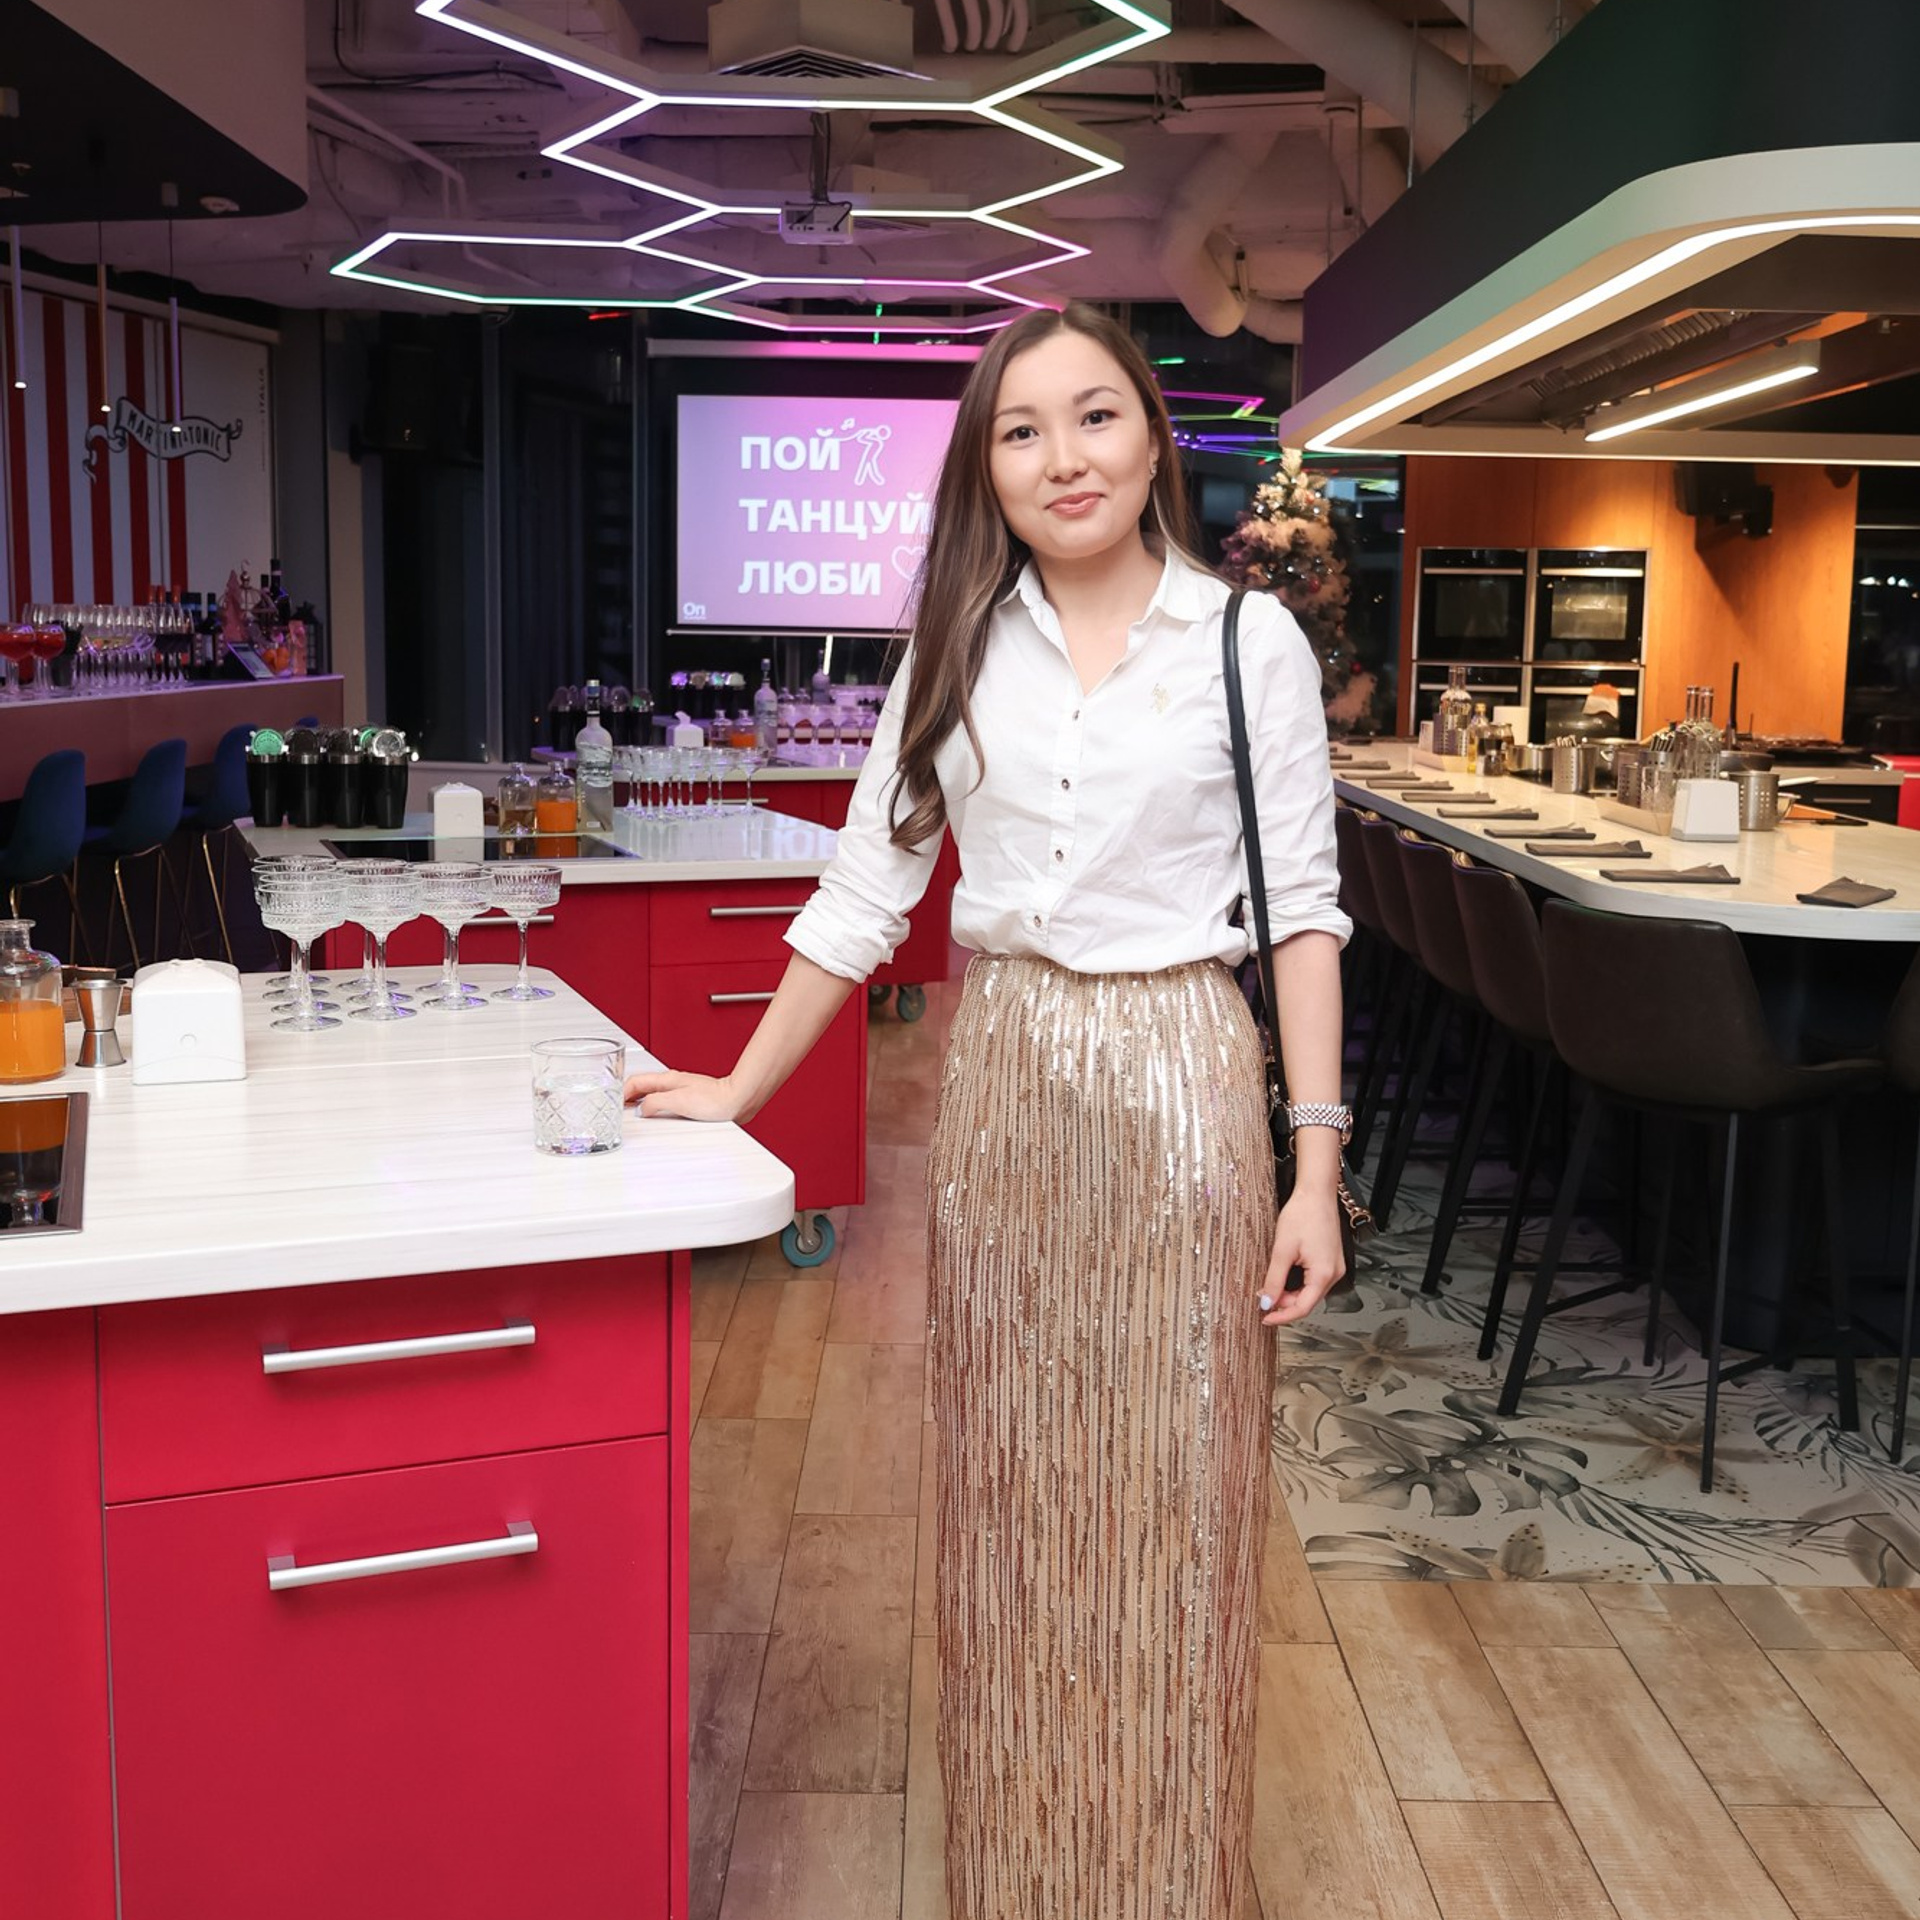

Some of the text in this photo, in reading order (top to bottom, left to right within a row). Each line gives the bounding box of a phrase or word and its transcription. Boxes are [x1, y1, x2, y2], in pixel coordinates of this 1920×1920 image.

[740, 428, 841, 471] ПОЙ
[738, 492, 931, 541] ТАНЦУЙ
[737, 560, 882, 596] ЛЮБИ
